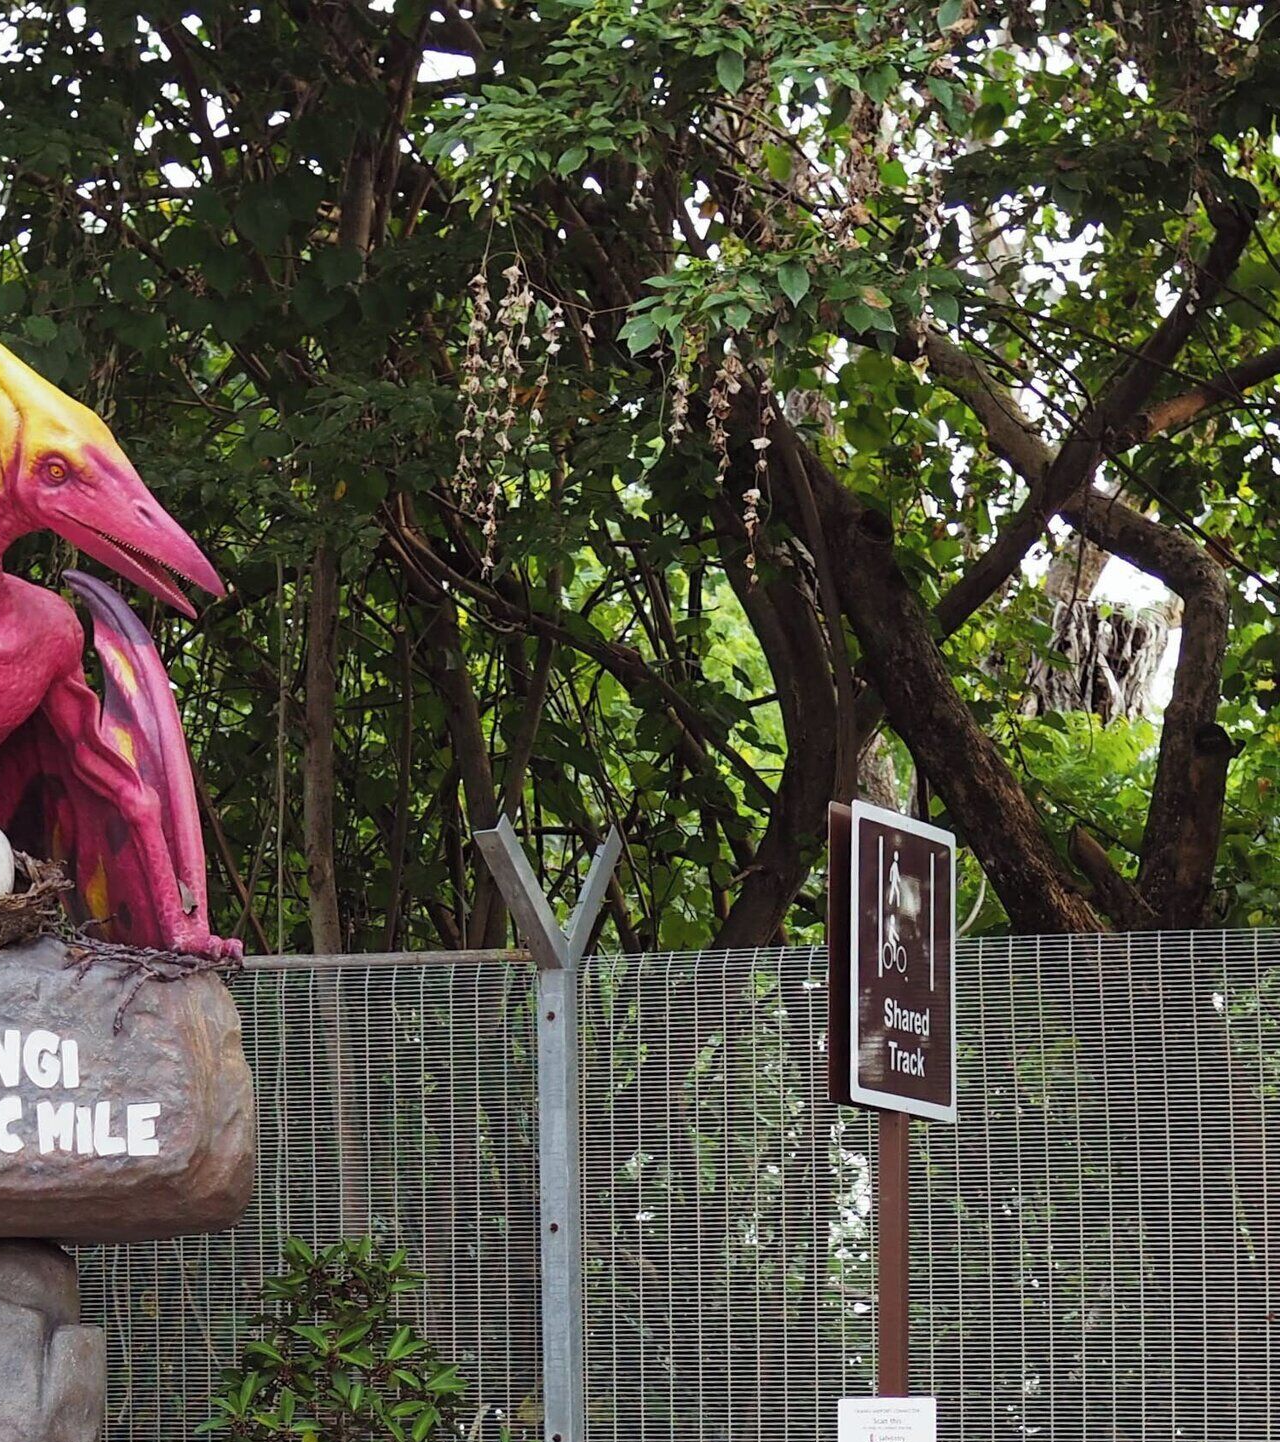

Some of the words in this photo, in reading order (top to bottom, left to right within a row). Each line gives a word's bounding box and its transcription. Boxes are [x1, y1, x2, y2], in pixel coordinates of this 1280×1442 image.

[883, 997, 930, 1038] Shared
[888, 1041, 925, 1077] Track
[36, 1101, 162, 1157] MILE
